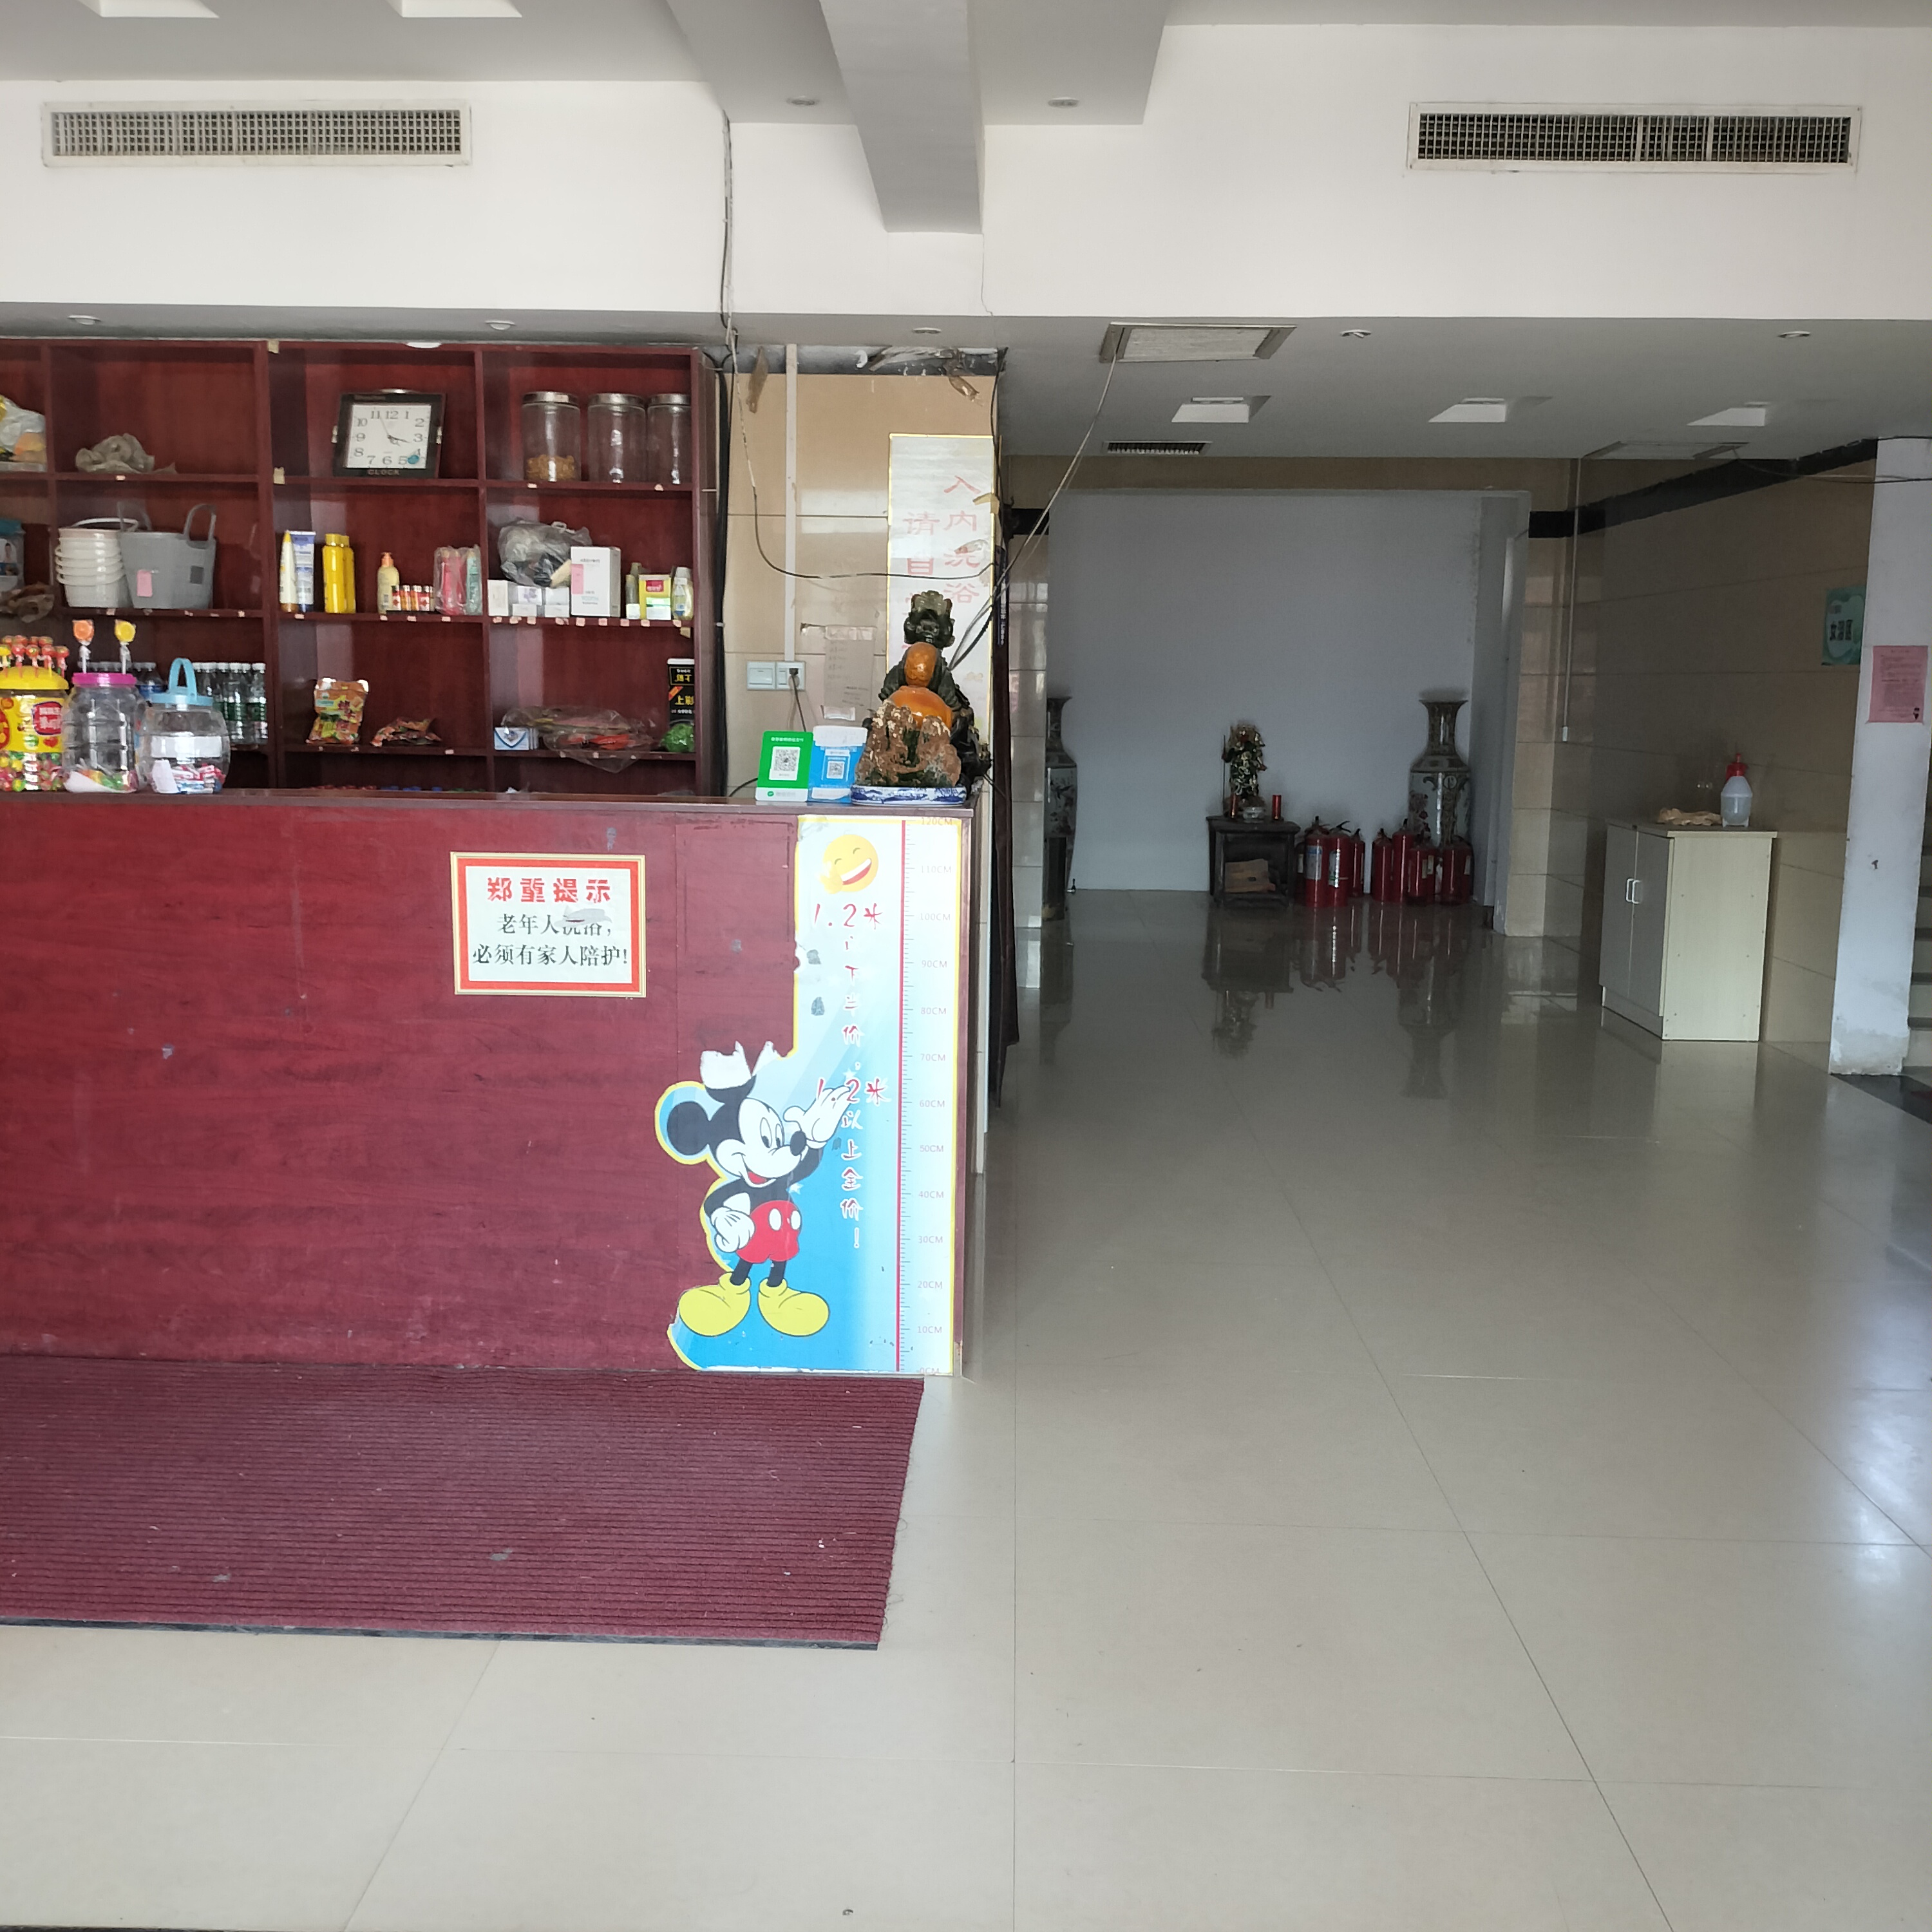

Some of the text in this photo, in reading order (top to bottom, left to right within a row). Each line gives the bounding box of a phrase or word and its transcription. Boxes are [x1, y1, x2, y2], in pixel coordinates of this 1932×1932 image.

[370, 410, 381, 419] 11
[386, 410, 399, 419] 12
[404, 411, 410, 419] 1
[357, 418, 368, 427] 10
[415, 419, 424, 428] 2
[355, 433, 366, 442] 9
[413, 433, 423, 442] 3
[354, 448, 364, 457] 8
[367, 455, 376, 465] 7
[382, 456, 392, 465] 6
[398, 456, 408, 465] 5
[943, 475, 982, 604] 入内洗浴
[921, 817, 952, 826] 120CM
[921, 865, 951, 874] 110CM
[487, 876, 611, 904] 郑重提示
[814, 902, 884, 930] 1.2米
[920, 913, 951, 922] 100CM
[472, 943, 628, 967] 必须有家人陪护！
[921, 960, 947, 969] 90CM
[920, 1007, 947, 1016] 80CM
[920, 1054, 946, 1062] 70CM
[919, 1100, 945, 1108] 60CM
[919, 1144, 944, 1153] 50CM
